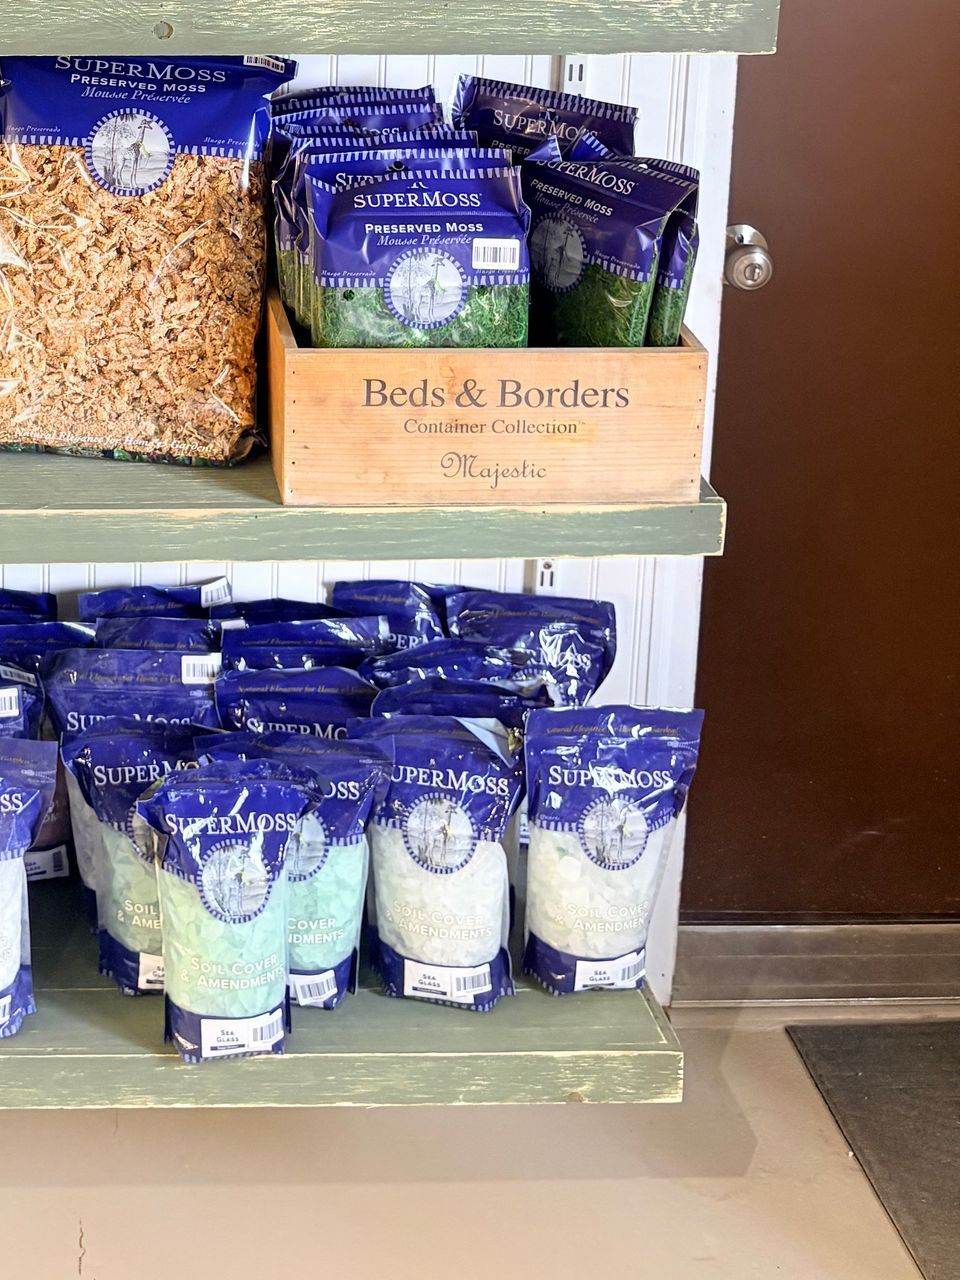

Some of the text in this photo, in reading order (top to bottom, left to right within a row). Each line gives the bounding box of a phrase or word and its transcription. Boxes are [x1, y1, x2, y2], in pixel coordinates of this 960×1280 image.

[70, 74, 206, 93] PRESERVED MOSS
[81, 86, 191, 105] Mousse Préservée
[353, 191, 481, 209] SUPERMOSS
[530, 179, 613, 216] PRESERVED MOSS
[365, 222, 483, 234] PRESERVED MOSS
[377, 234, 472, 246] Mousse Préservée
[362, 378, 630, 409] Beds & Borders
[404, 419, 486, 434] Container
[440, 452, 546, 489] Majestic
[191, 954, 278, 975] SOIL COVER
